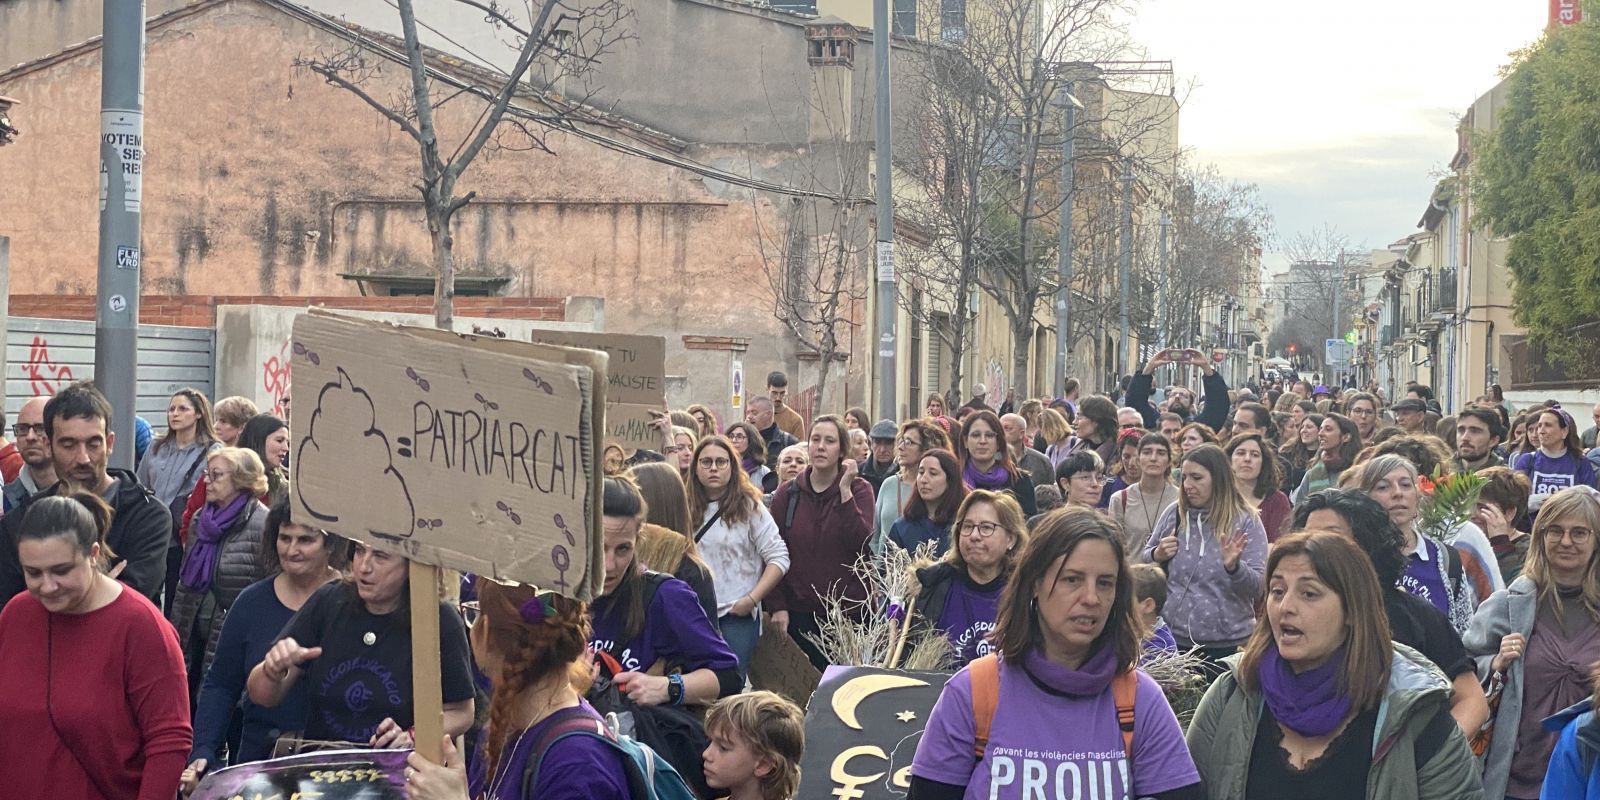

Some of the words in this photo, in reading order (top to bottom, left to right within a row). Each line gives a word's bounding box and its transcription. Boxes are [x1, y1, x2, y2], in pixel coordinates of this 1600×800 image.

[626, 418, 656, 442] MANT
[413, 400, 579, 500] PATRIARCAT
[992, 746, 1022, 757] Davant
[1025, 749, 1039, 758] les
[1041, 750, 1086, 760] violències
[989, 756, 1130, 800] PROU!
